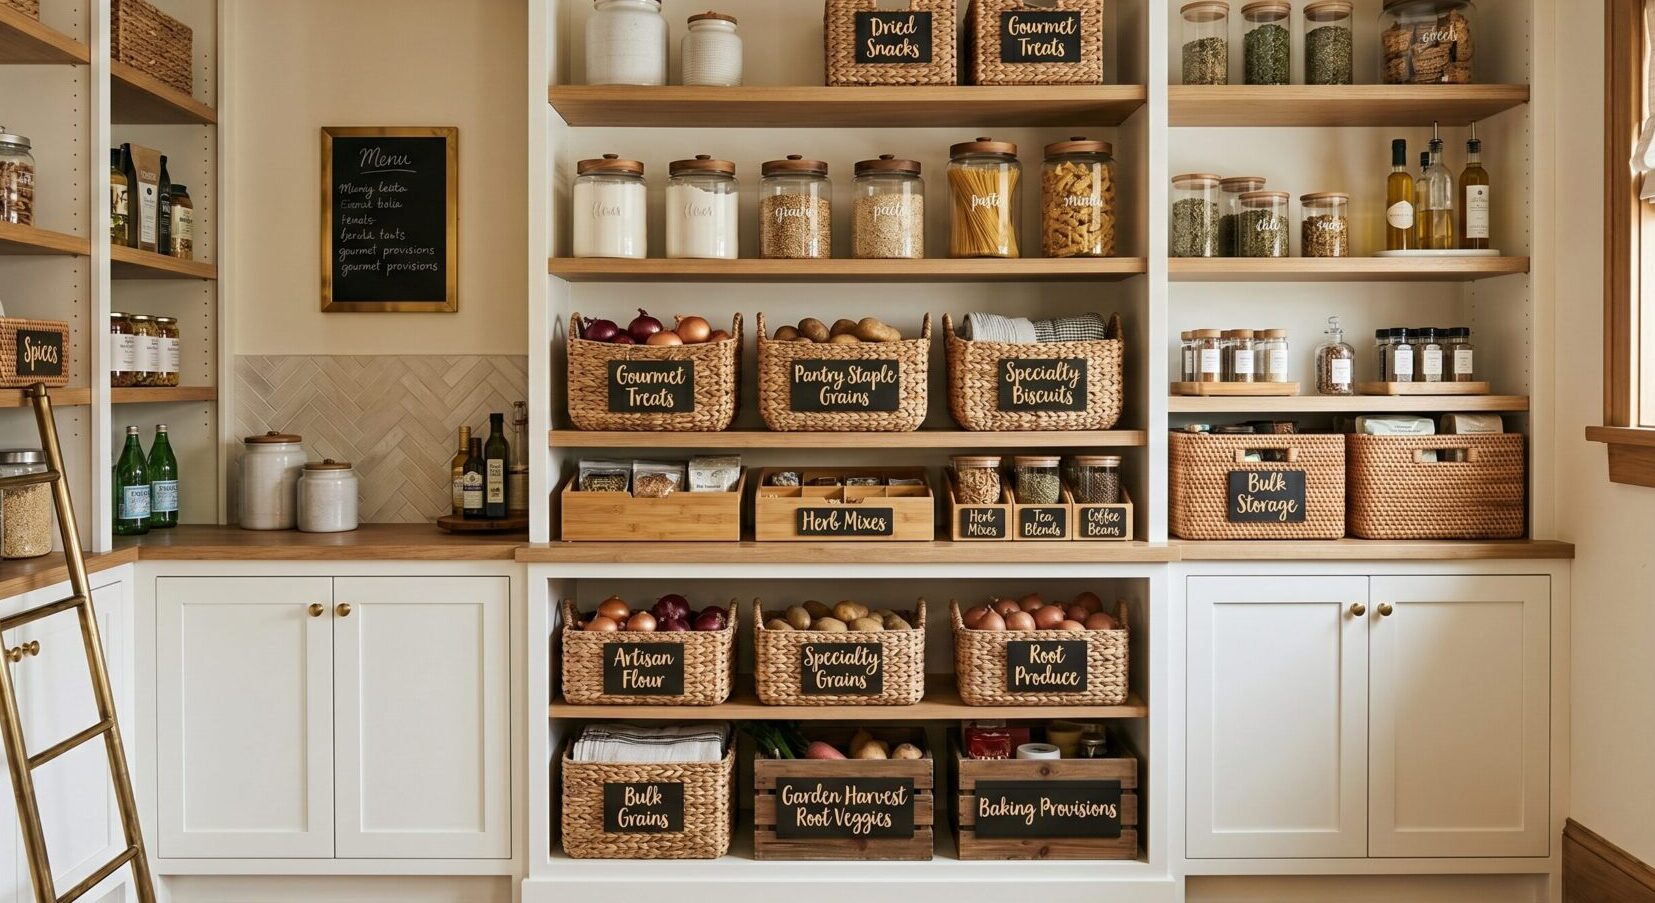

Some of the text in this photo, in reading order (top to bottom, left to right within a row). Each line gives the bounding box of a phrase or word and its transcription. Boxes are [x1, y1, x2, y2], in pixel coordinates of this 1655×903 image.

[869, 14, 918, 37] Dried
[1008, 15, 1078, 36] Gourmet
[866, 37, 920, 59] Snacks
[1017, 37, 1065, 58] Treats
[359, 147, 412, 168] Menu
[338, 243, 435, 262] gourmet provisions
[341, 260, 439, 278] gourmet provisions
[24, 336, 58, 371] Spices
[616, 364, 686, 385] Gourmet
[794, 364, 898, 391] Pantry Staple
[1005, 361, 1081, 389] Specialty
[625, 386, 674, 408] Treats
[819, 383, 870, 407] Grains
[1012, 383, 1076, 406] Biscuits
[1248, 471, 1287, 494] Bulk
[969, 508, 996, 523] Herb
[1032, 509, 1054, 523] Tea
[1087, 507, 1121, 525] Coffee
[1236, 493, 1299, 522] Storage
[802, 510, 888, 532] Herb Mixes
[967, 522, 997, 537] Mixes
[1024, 521, 1061, 537] Blends
[1088, 522, 1121, 537] Beans
[613, 647, 675, 668] Artisan
[803, 645, 881, 676] Specialty
[1029, 643, 1067, 664] Root
[622, 668, 665, 689] Flour
[814, 667, 871, 690] Grains
[1015, 663, 1081, 686] Produce
[624, 785, 662, 807] Bulk
[782, 783, 908, 806] Garden Harvest
[617, 807, 669, 829] Grains
[796, 806, 892, 835] Root Veggies
[979, 796, 1117, 826] Baking Provisions
